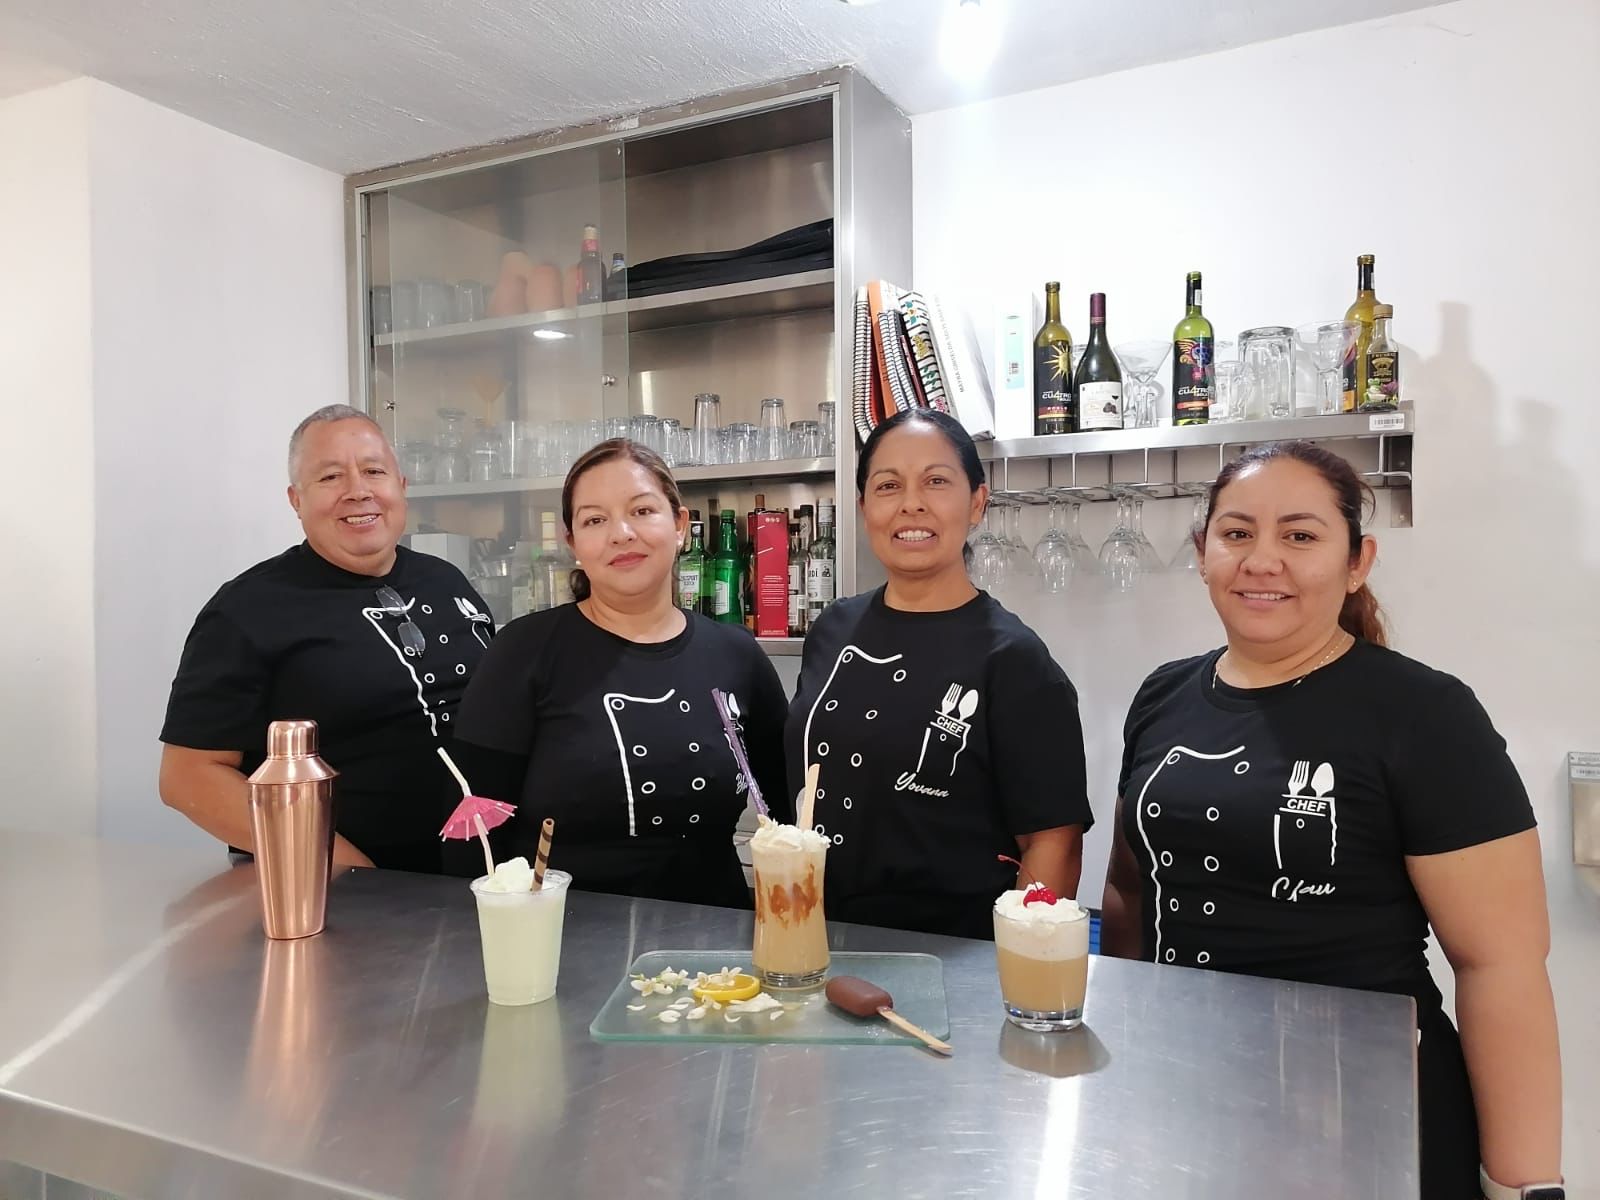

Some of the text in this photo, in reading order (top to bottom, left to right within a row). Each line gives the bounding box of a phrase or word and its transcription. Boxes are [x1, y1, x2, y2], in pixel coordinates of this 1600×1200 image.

[936, 716, 965, 735] CHEF
[894, 771, 950, 799] Yovana
[1286, 798, 1328, 813] CHEF
